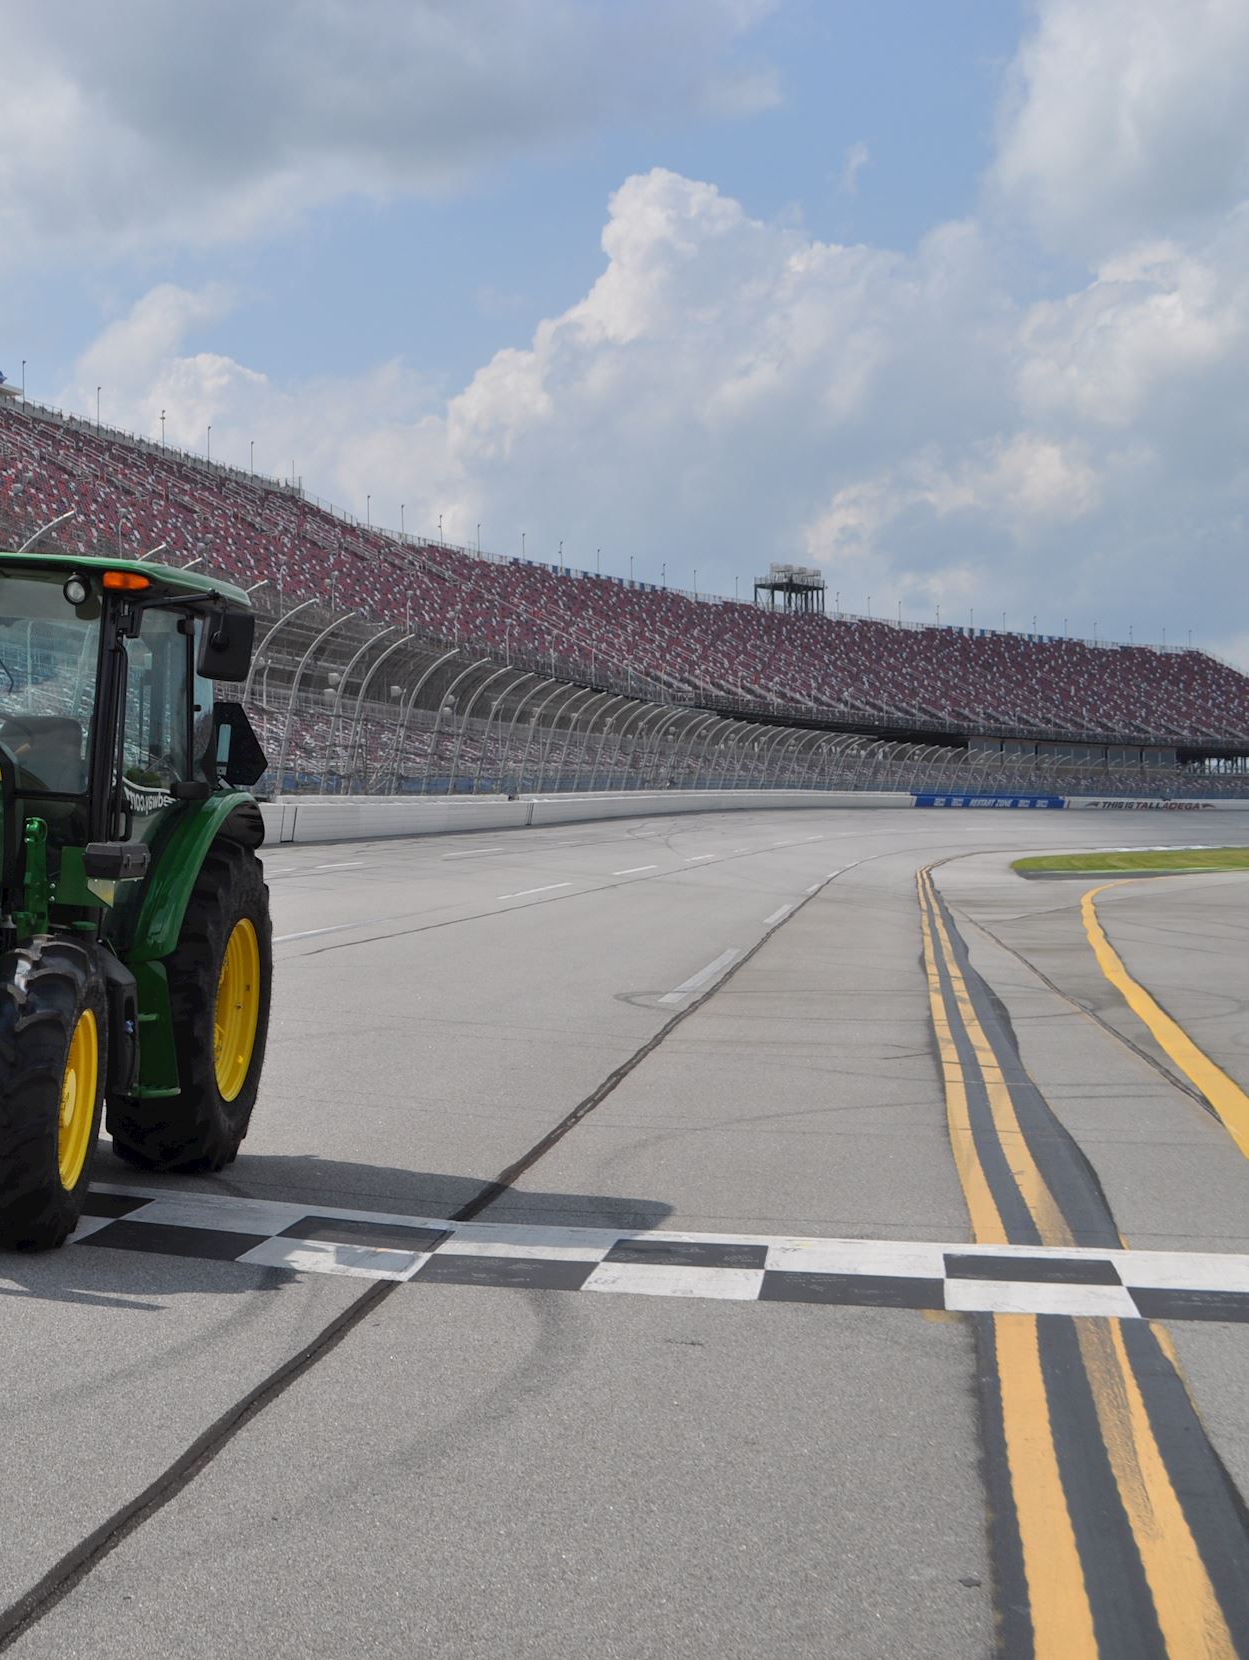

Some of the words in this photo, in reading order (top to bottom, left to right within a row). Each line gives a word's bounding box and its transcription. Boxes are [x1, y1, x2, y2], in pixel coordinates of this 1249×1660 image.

[1102, 801, 1125, 809] THIS
[1125, 801, 1134, 809] IS
[1135, 802, 1200, 810] TALLADEGA
